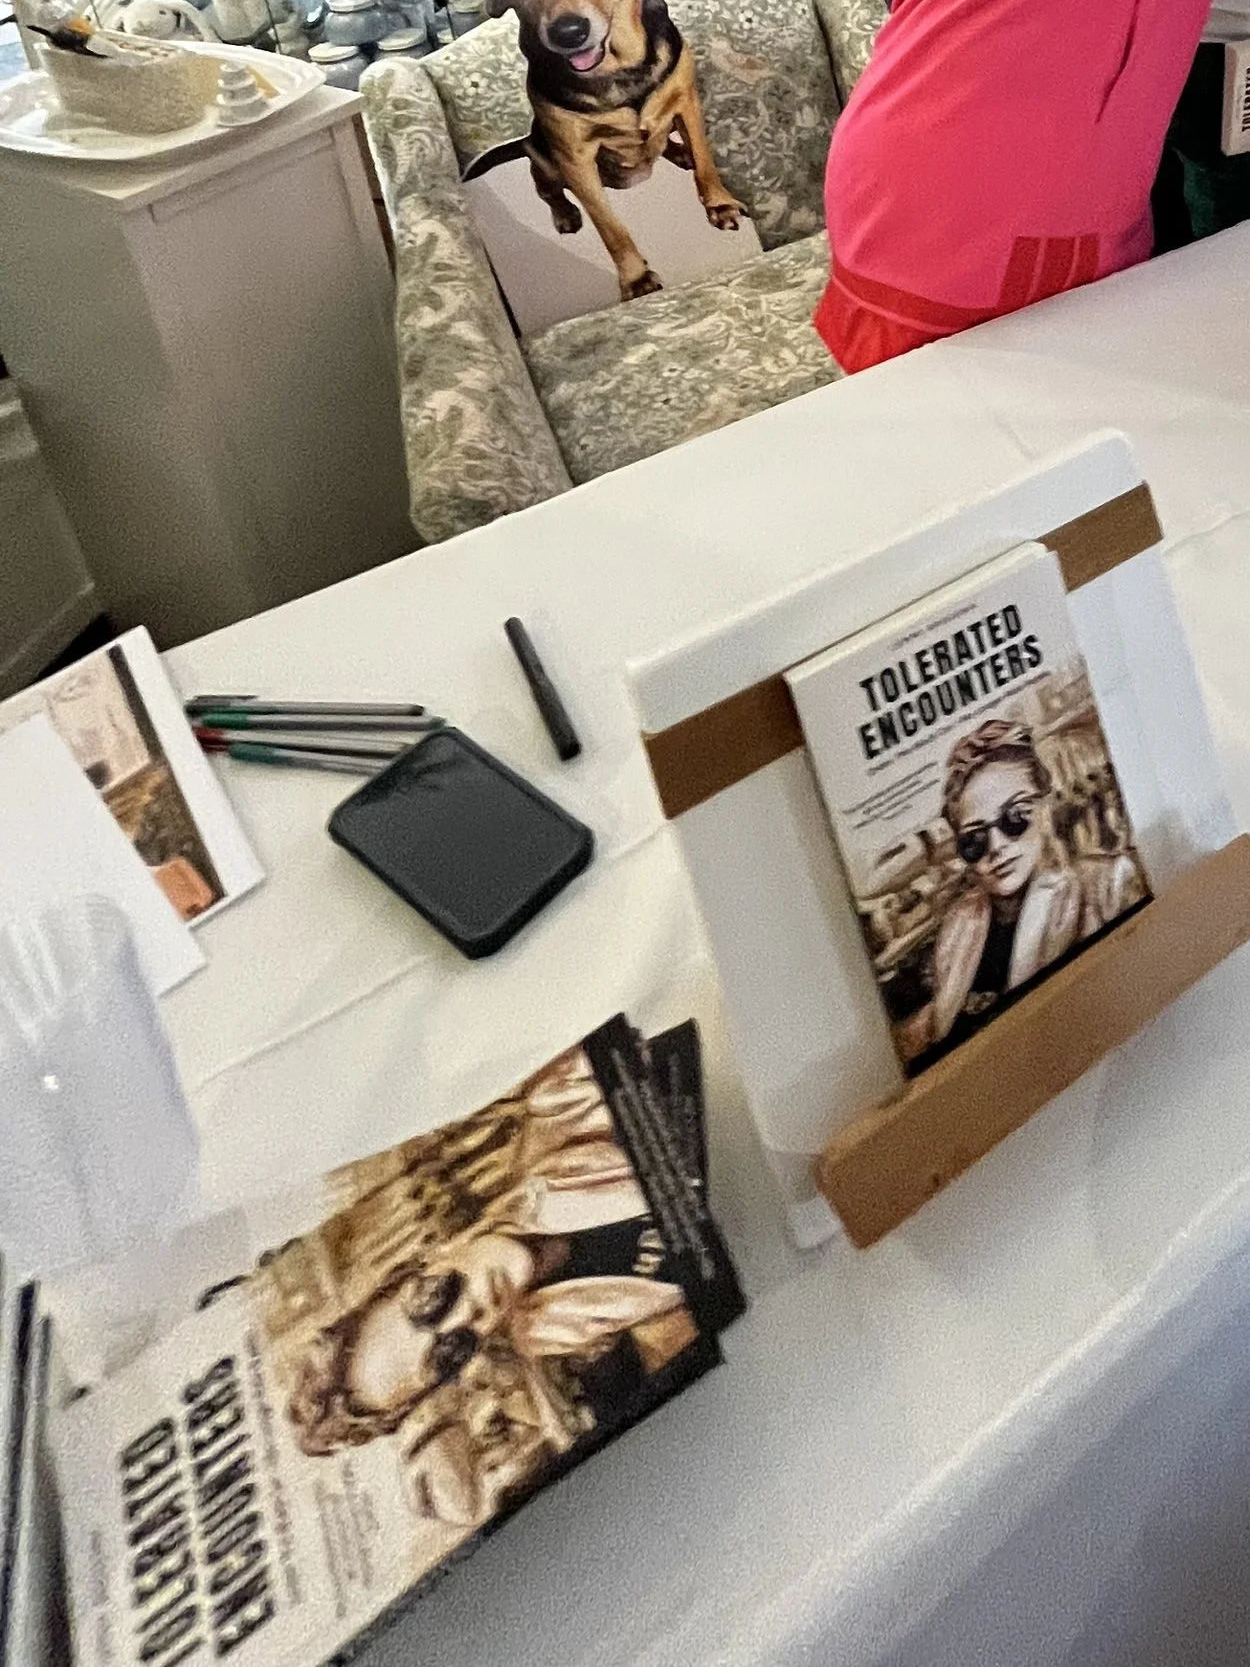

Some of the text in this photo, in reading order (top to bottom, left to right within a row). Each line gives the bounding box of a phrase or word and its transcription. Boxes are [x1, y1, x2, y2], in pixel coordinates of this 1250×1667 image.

[859, 604, 1022, 711] TOLERATED
[859, 634, 1042, 759] ENCOUNTERS
[181, 1356, 275, 1657] ENCOUNTERS
